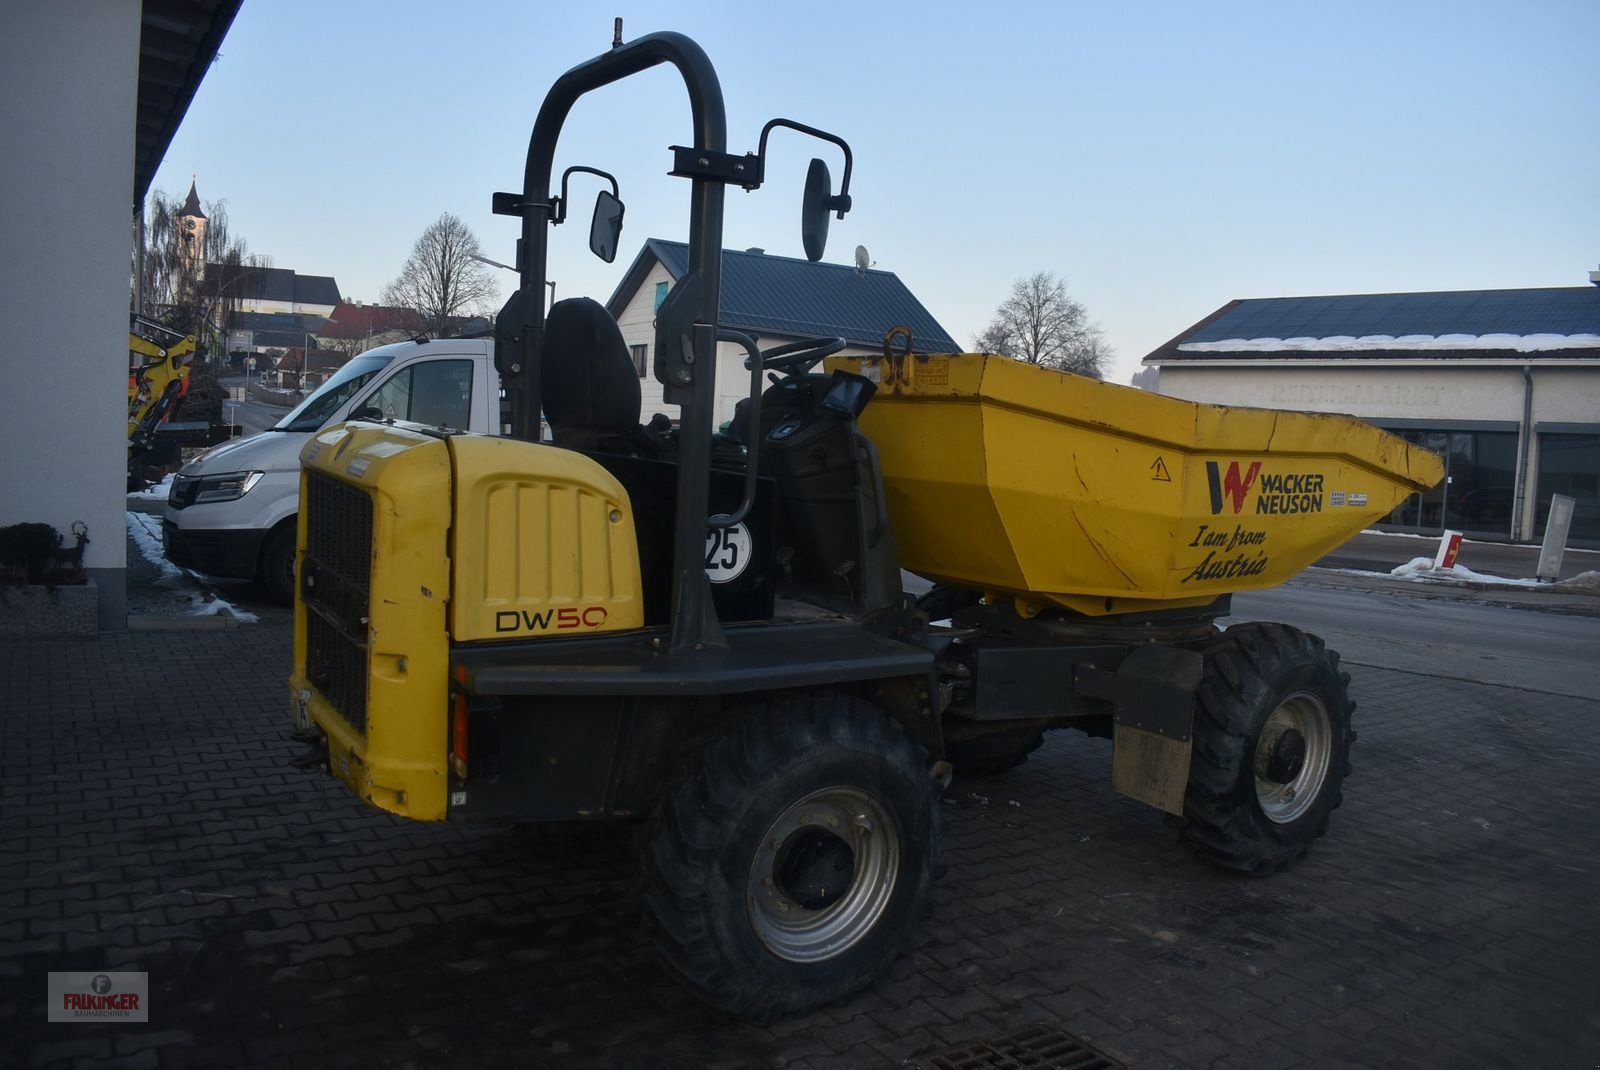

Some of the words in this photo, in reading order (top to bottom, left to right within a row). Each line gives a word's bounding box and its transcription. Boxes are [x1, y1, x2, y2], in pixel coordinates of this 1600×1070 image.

[1260, 473, 1325, 494] WACKER
[1255, 493, 1323, 515] NEUSON
[704, 527, 739, 570] 25
[1188, 525, 1208, 547] I
[1202, 530, 1228, 547] am
[1225, 524, 1266, 552] from
[1181, 550, 1269, 584] Austria
[496, 606, 608, 632] DW50
